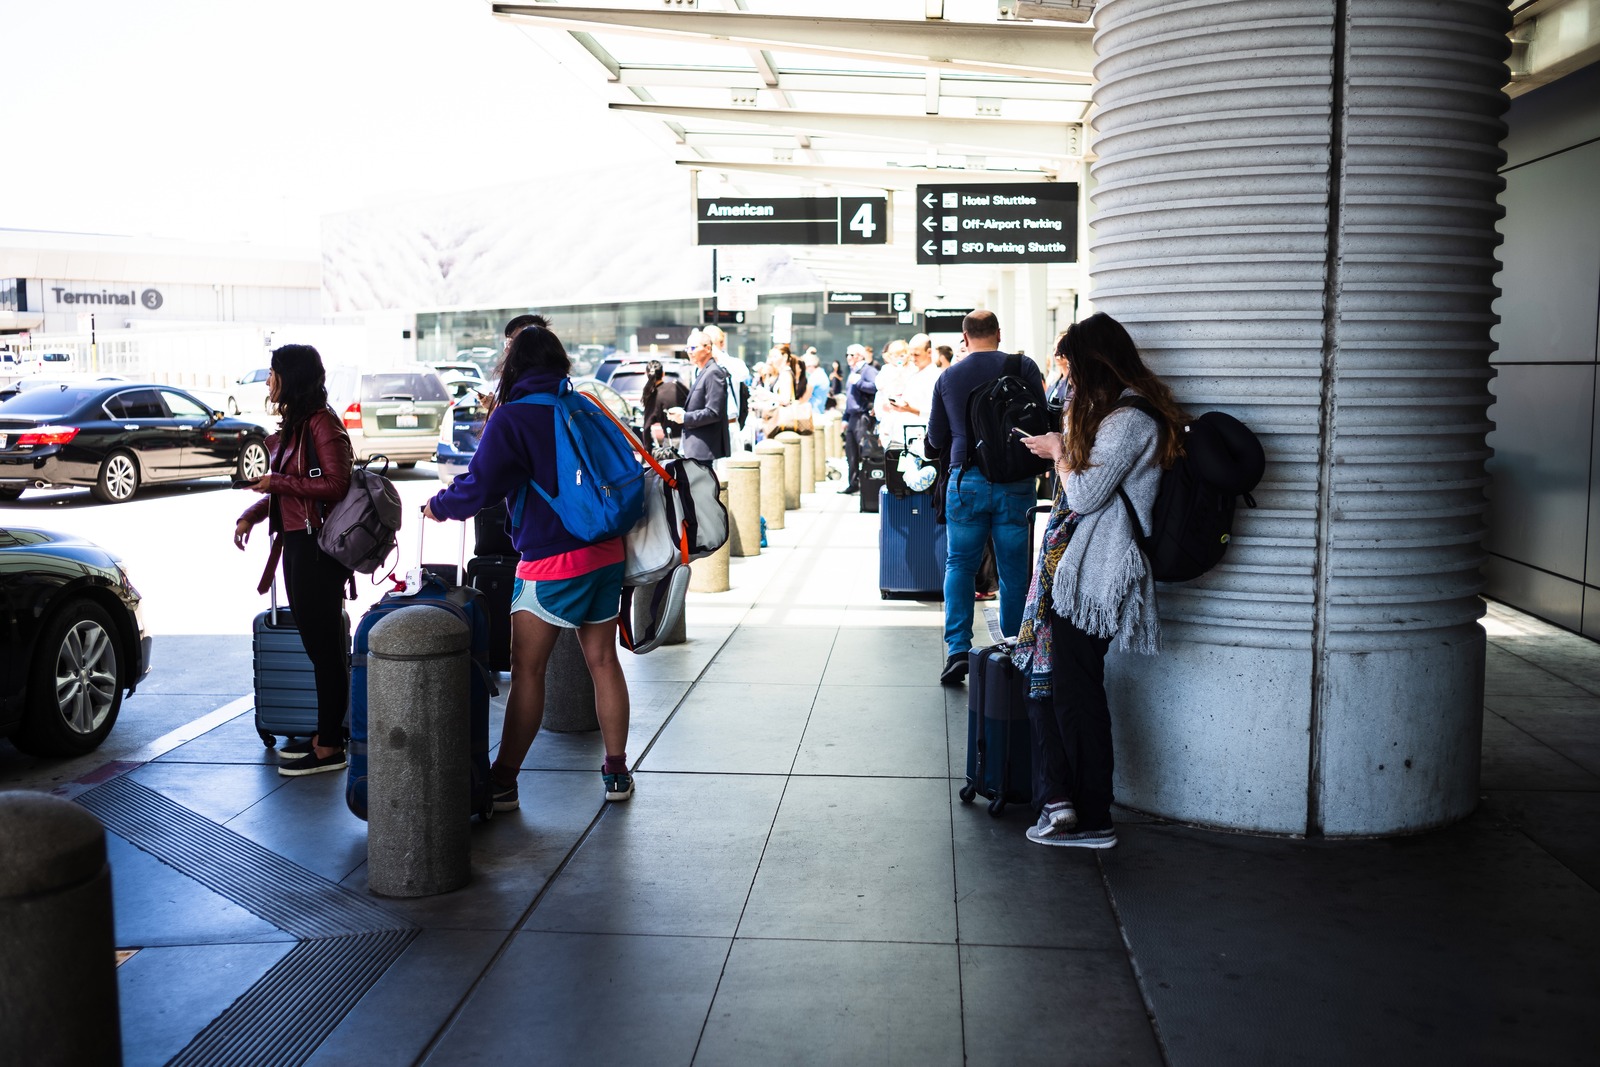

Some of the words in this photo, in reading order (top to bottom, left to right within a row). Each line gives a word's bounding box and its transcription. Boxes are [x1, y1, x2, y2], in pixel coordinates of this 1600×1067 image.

[961, 195, 990, 206] Hotel
[992, 195, 1037, 206] Shuttles
[706, 203, 775, 217] American
[849, 203, 877, 238] 4
[961, 219, 1021, 231] Off-Airport
[1023, 219, 1062, 231] Parking
[961, 242, 985, 253] SFO
[986, 242, 1026, 254] Parking
[1028, 242, 1067, 253] Shuttle
[51, 287, 136, 305] Terminal
[893, 293, 907, 311] 5
